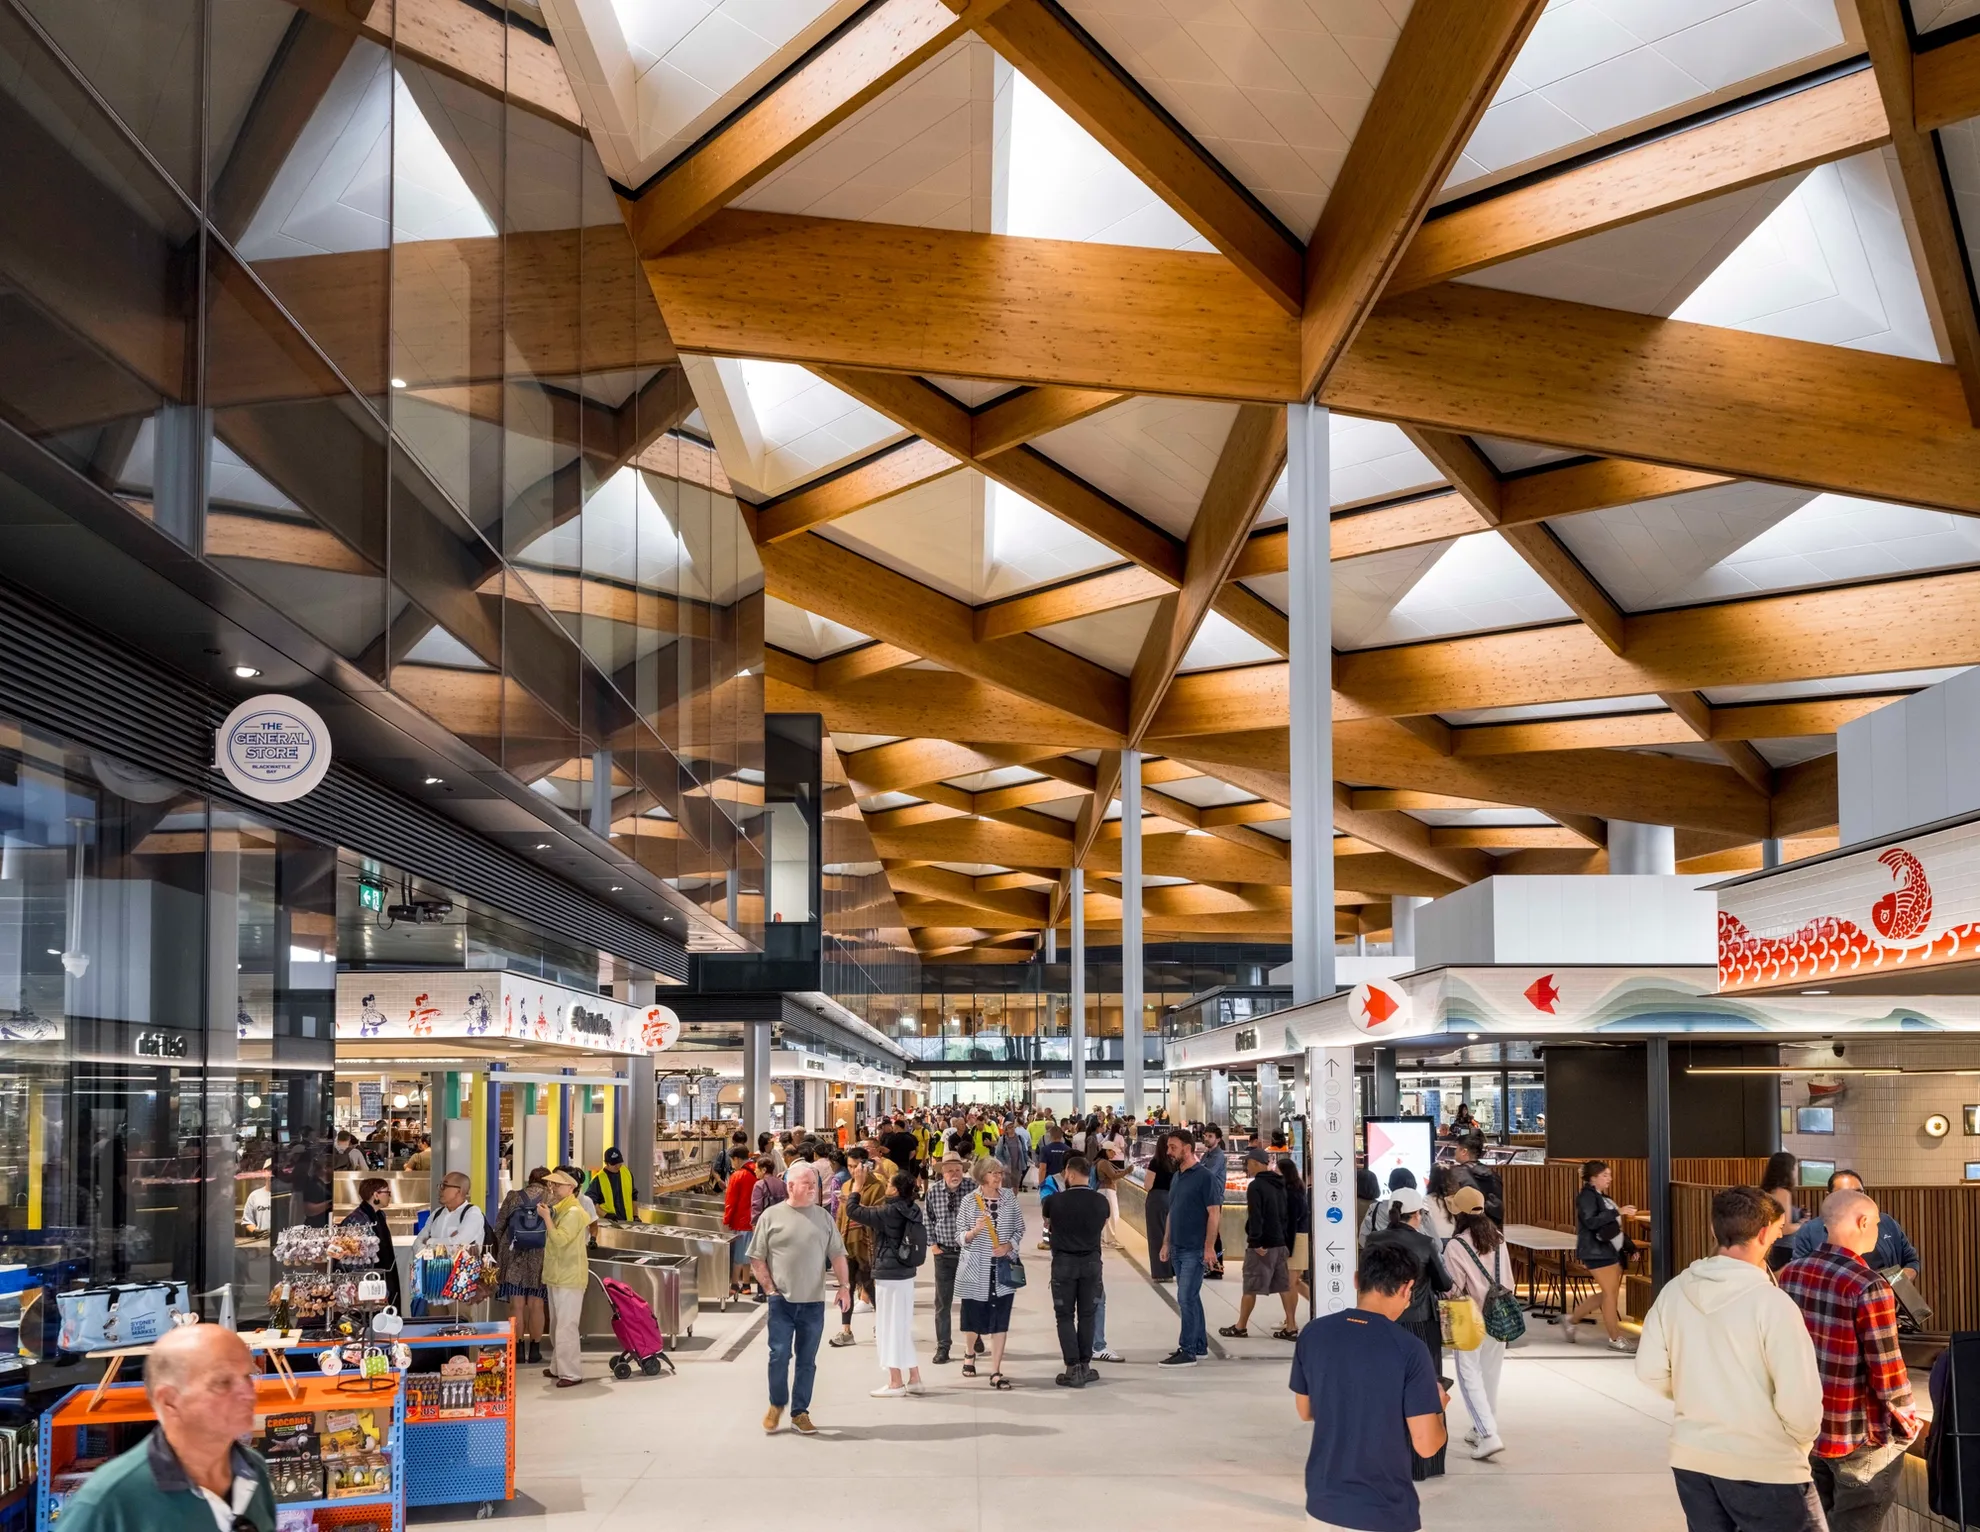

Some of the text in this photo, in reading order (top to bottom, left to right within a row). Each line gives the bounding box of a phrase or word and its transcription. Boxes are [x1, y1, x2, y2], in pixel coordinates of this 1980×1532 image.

[261, 722, 282, 730] THE
[235, 733, 309, 745] GENERAL
[245, 747, 298, 759] STORE
[267, 1417, 312, 1427] CROCODILE
[295, 1423, 308, 1431] EGG
